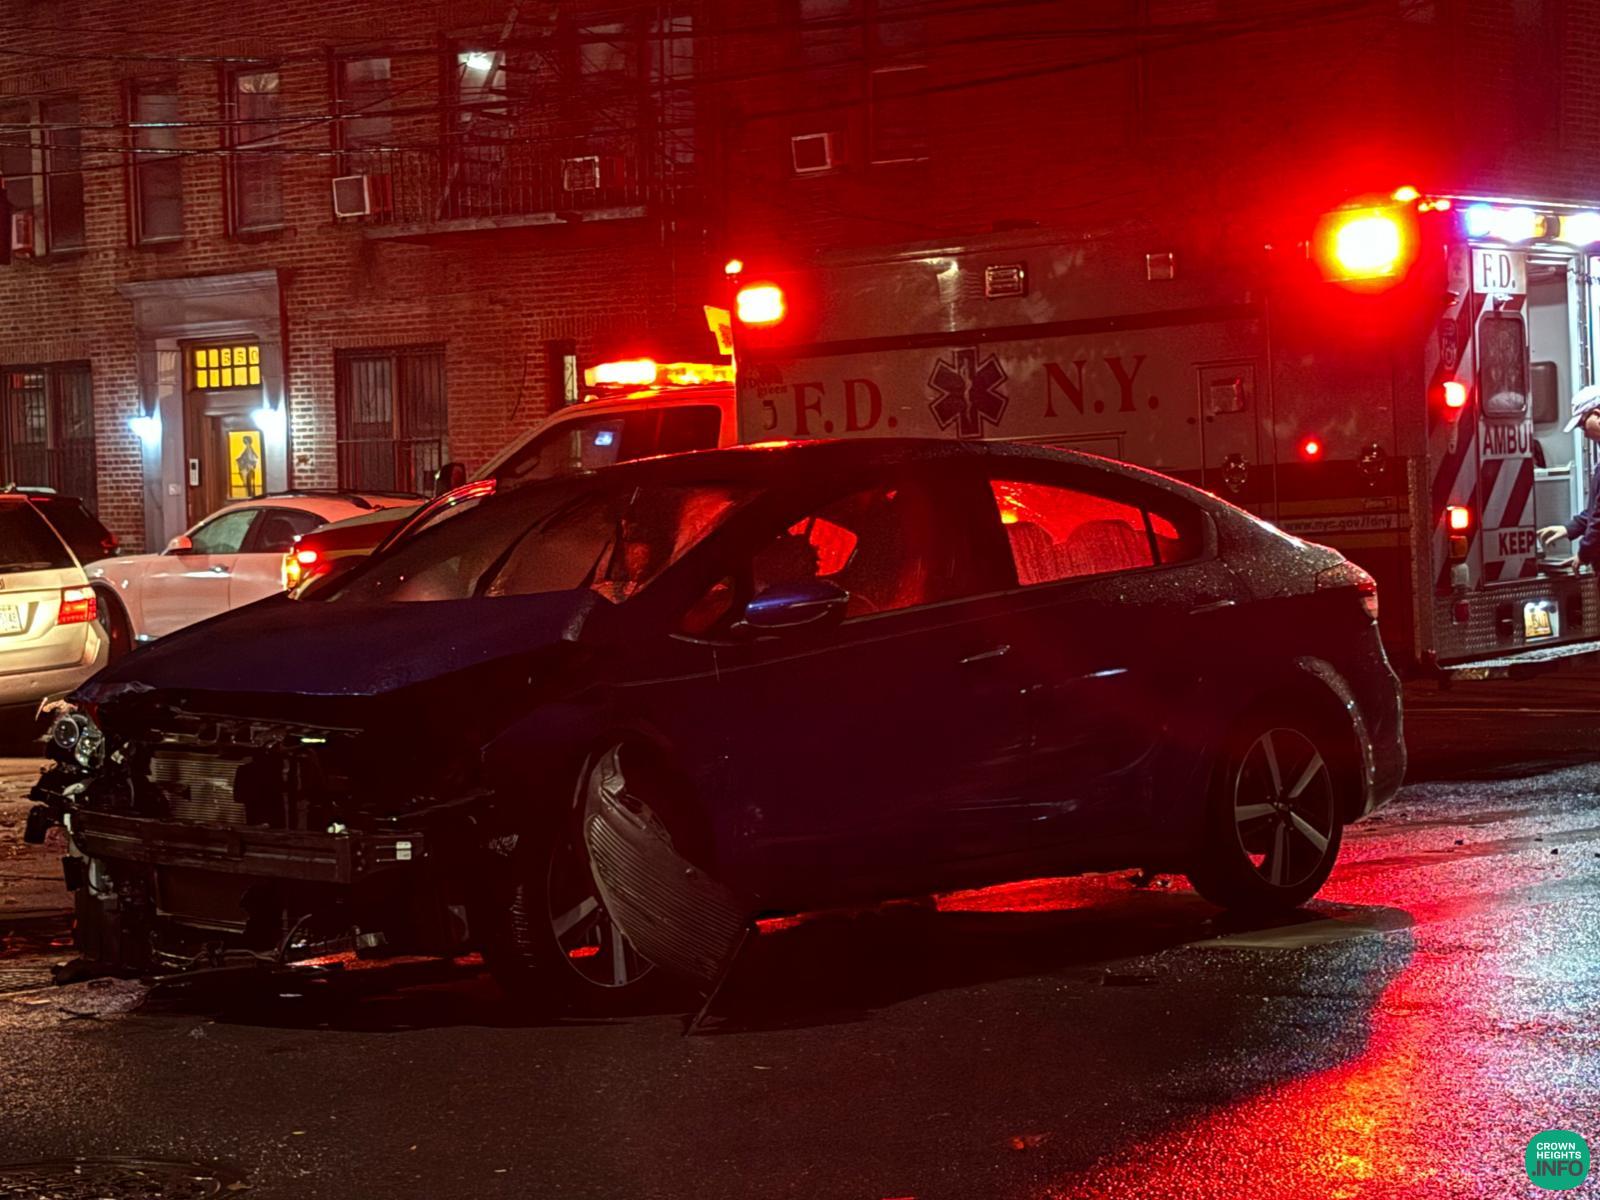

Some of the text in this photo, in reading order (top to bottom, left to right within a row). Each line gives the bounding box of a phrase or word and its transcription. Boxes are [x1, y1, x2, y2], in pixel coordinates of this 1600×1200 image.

[1482, 253, 1516, 288] F.D.
[792, 354, 1160, 435] F.D. N.Y.
[1498, 530, 1536, 556] KEEP
